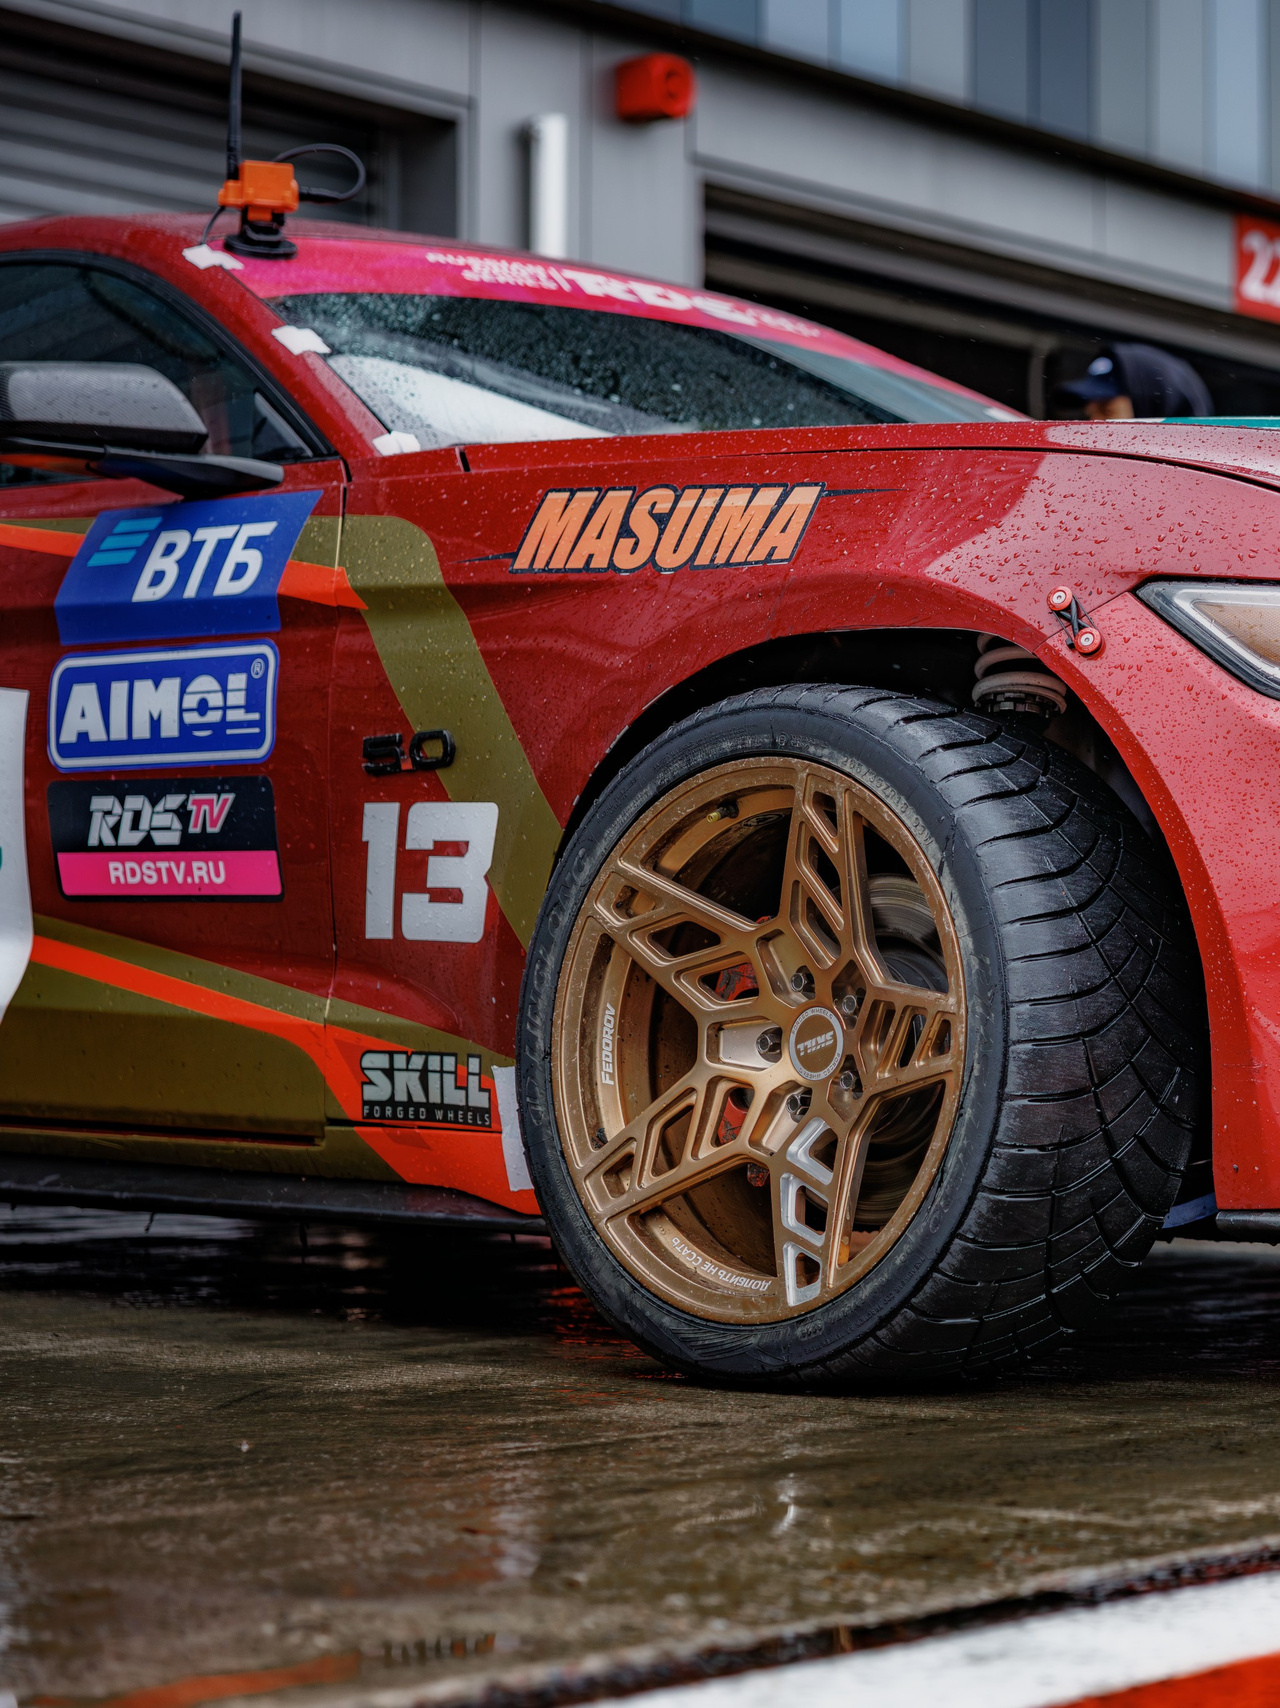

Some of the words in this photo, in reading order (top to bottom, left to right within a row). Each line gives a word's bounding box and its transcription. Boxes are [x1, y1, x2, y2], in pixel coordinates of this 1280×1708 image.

[132, 520, 278, 602] ВТБ
[511, 484, 824, 572] MASUMA
[108, 860, 226, 884] RDSTV.RU
[361, 802, 499, 943] 13
[601, 1002, 616, 1086] FEDOROV
[796, 1030, 835, 1057] SKILL
[360, 1052, 490, 1109] SKILL
[363, 1105, 426, 1120] FORGED
[434, 1108, 490, 1126] WHEELS
